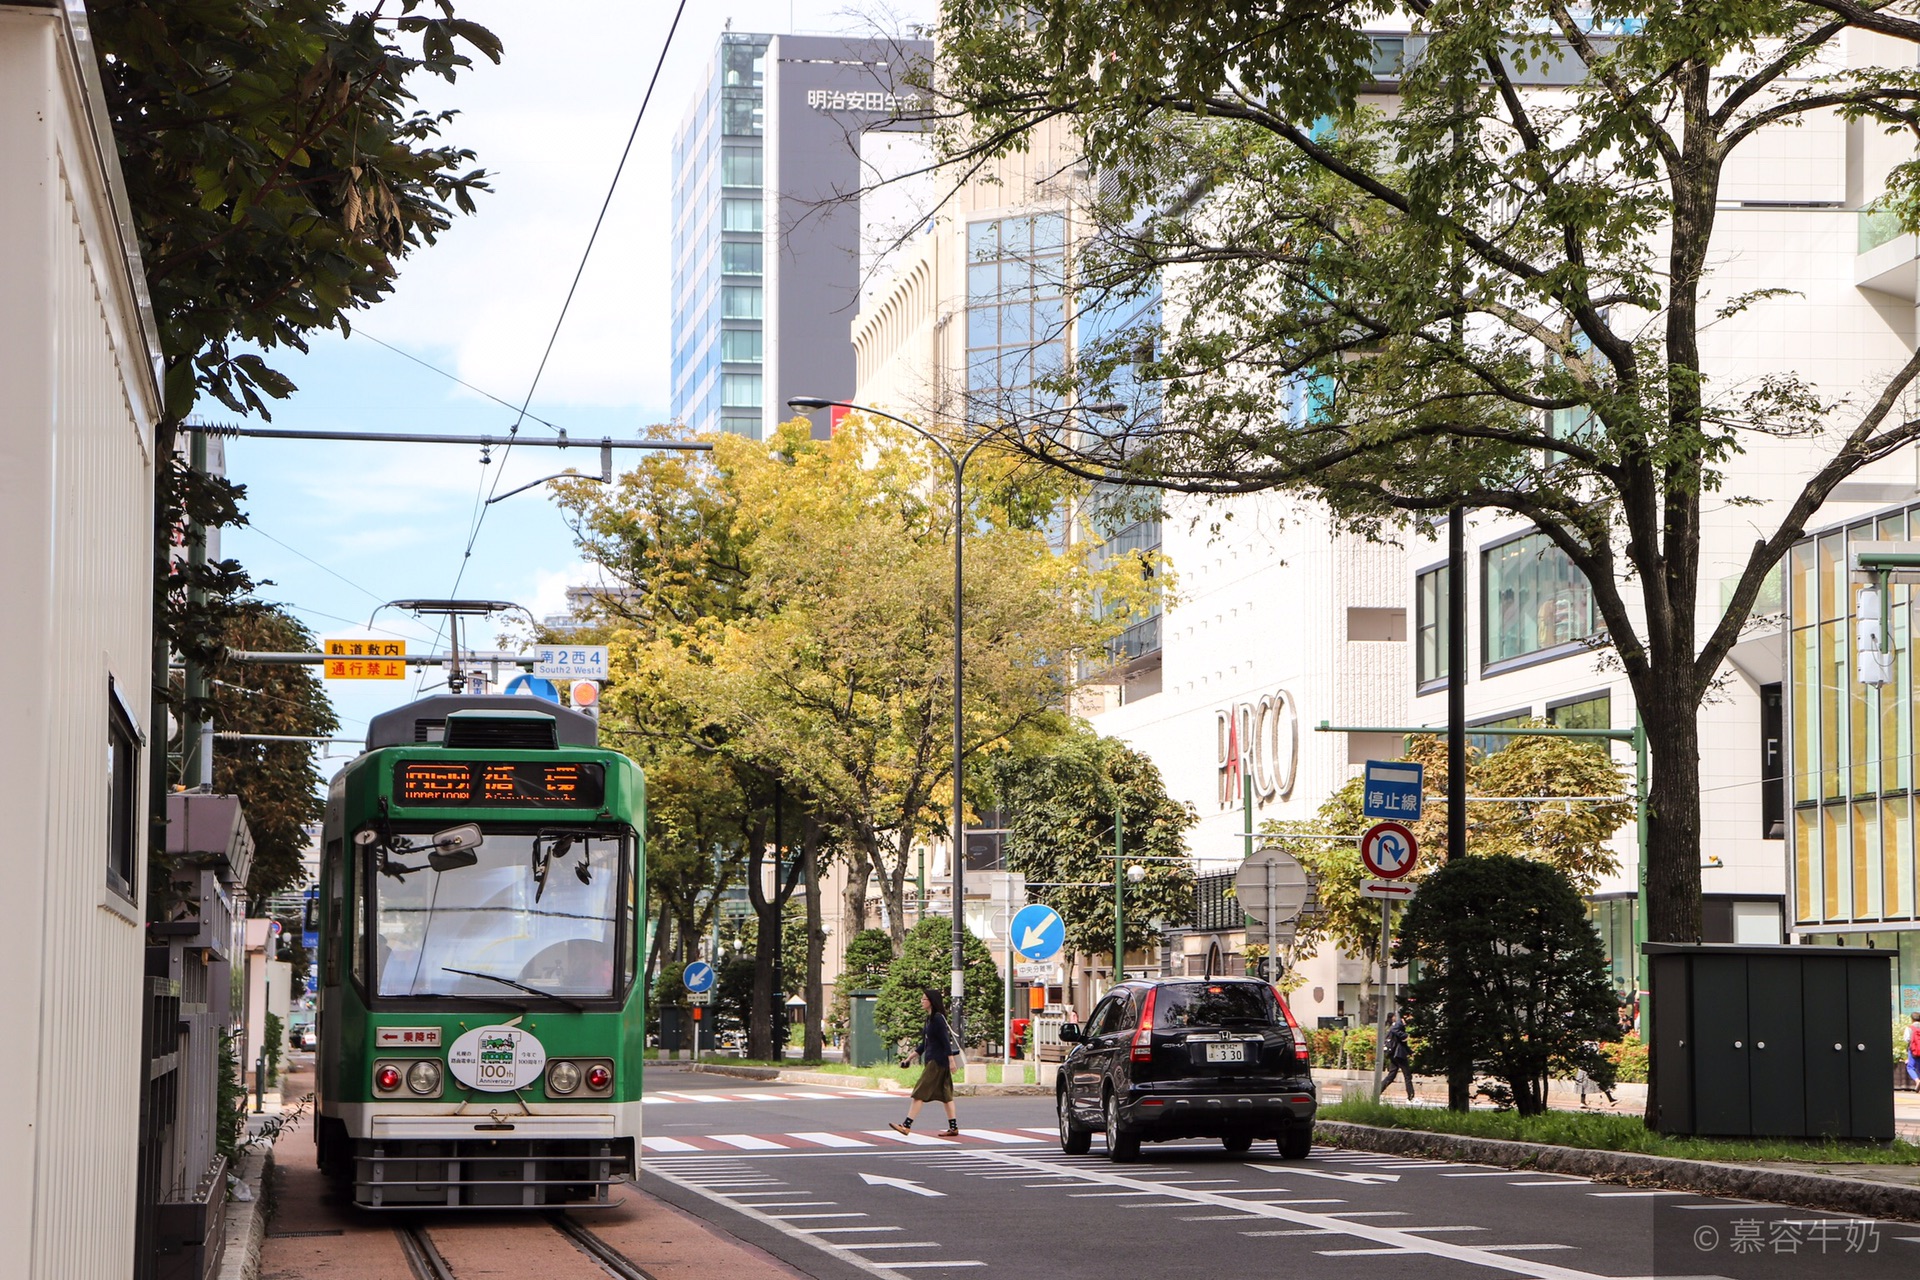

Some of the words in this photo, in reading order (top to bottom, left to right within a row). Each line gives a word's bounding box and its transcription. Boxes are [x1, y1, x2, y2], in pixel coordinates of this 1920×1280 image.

[332, 643, 398, 655] 軌道敷内
[332, 661, 398, 676] 通行禁止
[1215, 689, 1299, 803] PARCO
[1767, 738, 1778, 766] F
[1368, 791, 1417, 811] 停止線
